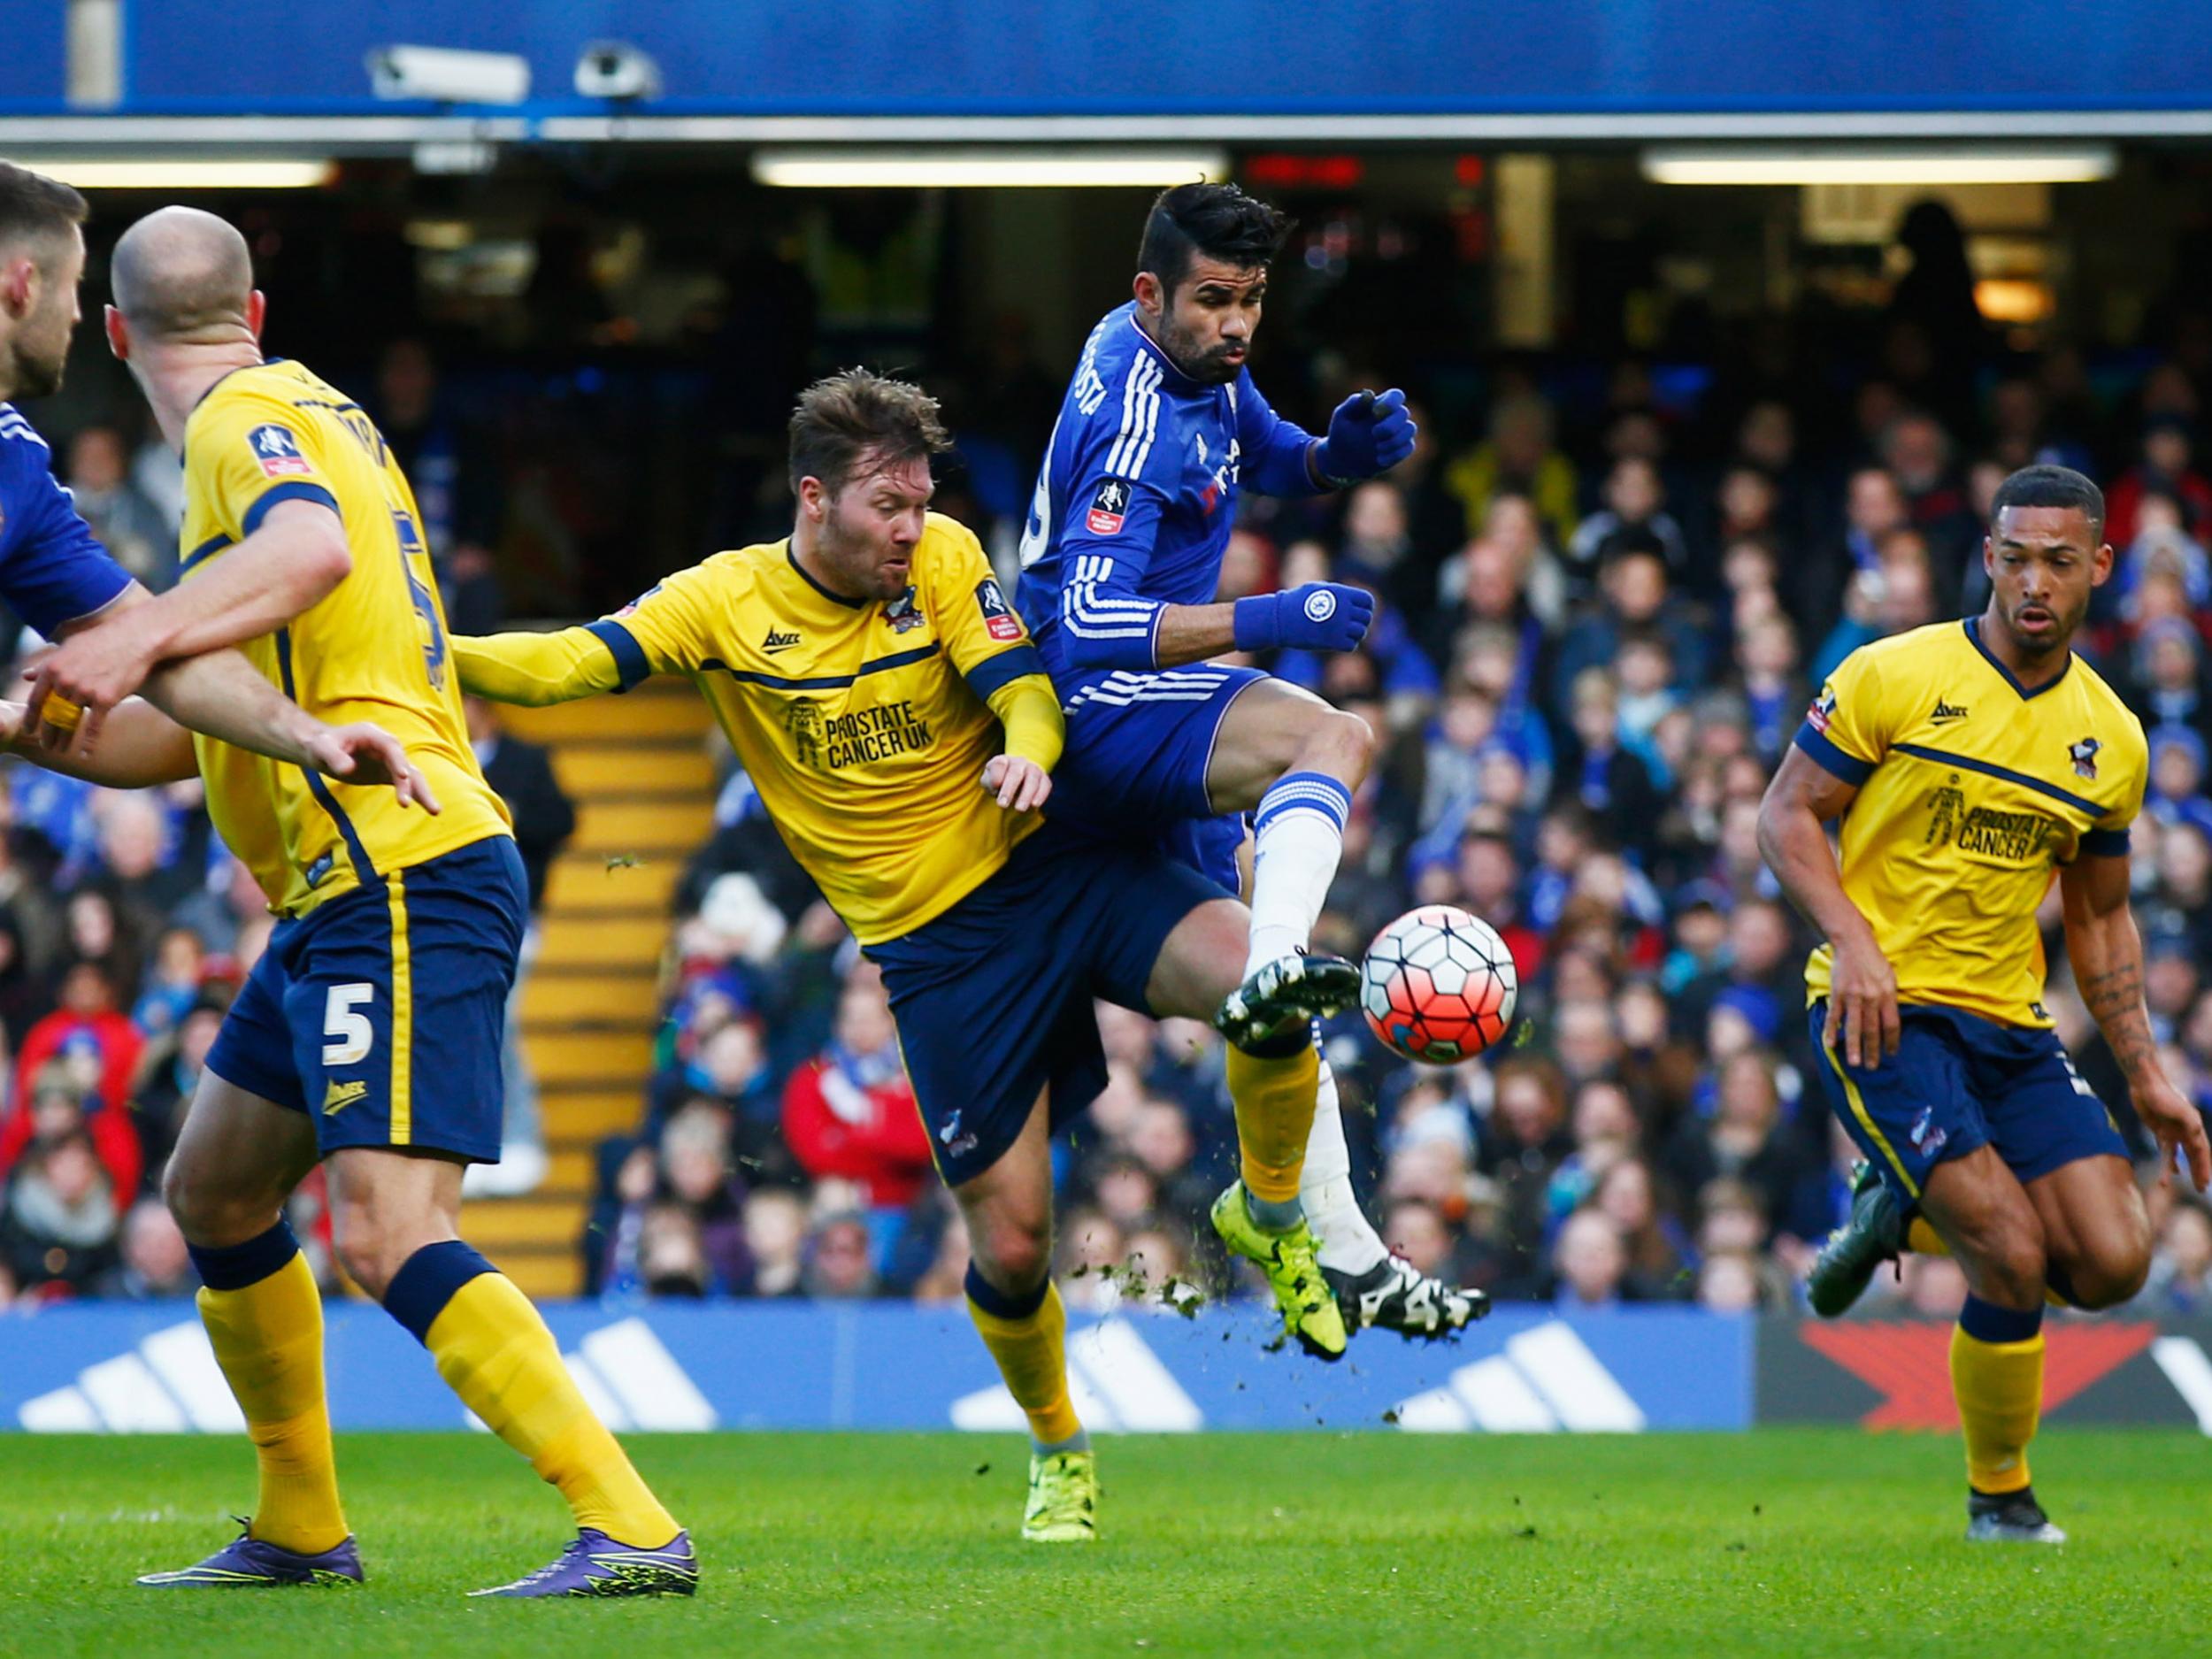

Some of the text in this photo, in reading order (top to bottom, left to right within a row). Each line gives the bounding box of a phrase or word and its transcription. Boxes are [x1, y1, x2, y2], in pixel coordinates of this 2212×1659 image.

[825, 700, 917, 744] PROSTATE
[827, 719, 933, 769] CANCER UK
[1958, 825, 2029, 861] CANCER
[322, 982, 373, 1065] 5
